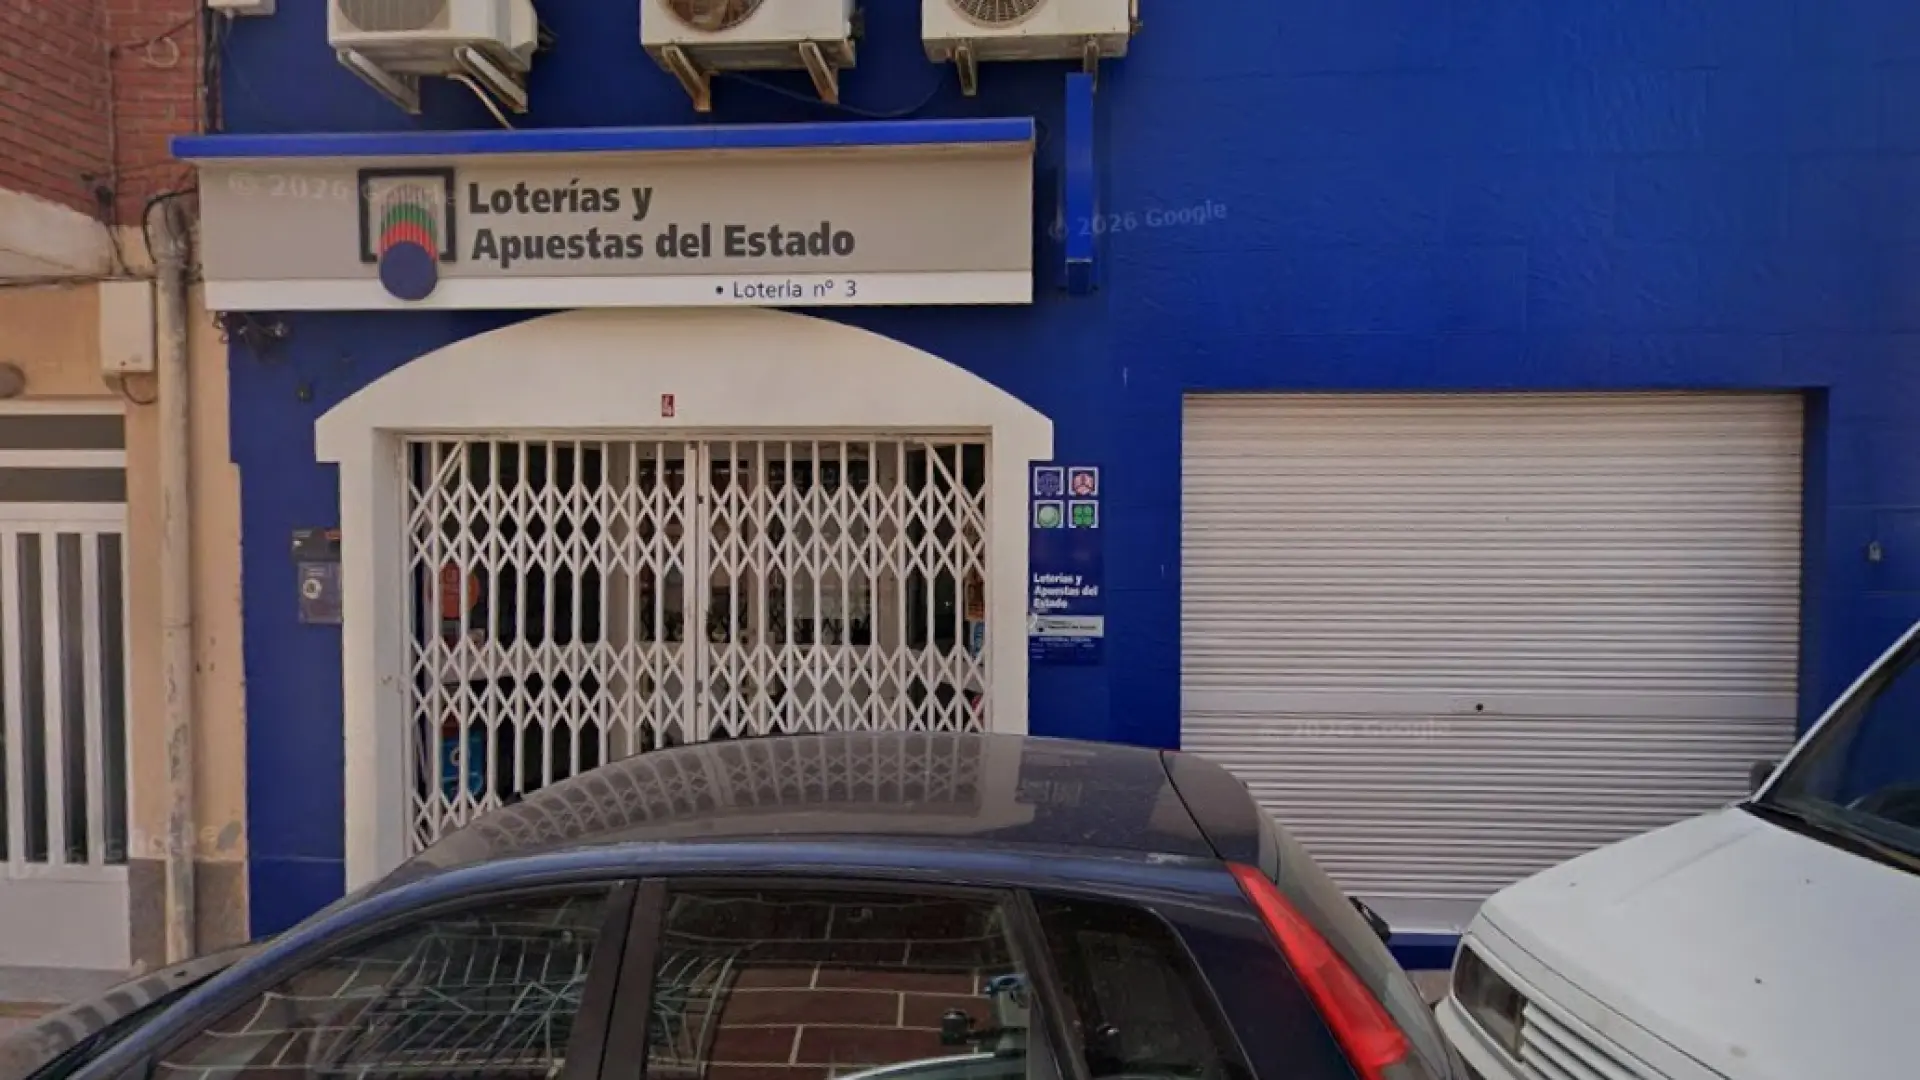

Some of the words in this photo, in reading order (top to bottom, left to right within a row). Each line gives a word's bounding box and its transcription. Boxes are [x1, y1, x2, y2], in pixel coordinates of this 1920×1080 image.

[468, 178, 620, 214] Loterías
[631, 185, 653, 221] y
[472, 226, 644, 268] Apuestas
[655, 222, 711, 258] del
[724, 221, 855, 258] Estado
[733, 279, 802, 298] Lotería
[845, 280, 857, 297] 3
[1075, 575, 1083, 586] y
[1034, 585, 1080, 598] Apuestas
[1081, 584, 1099, 596] del
[1033, 598, 1068, 609] Estado
